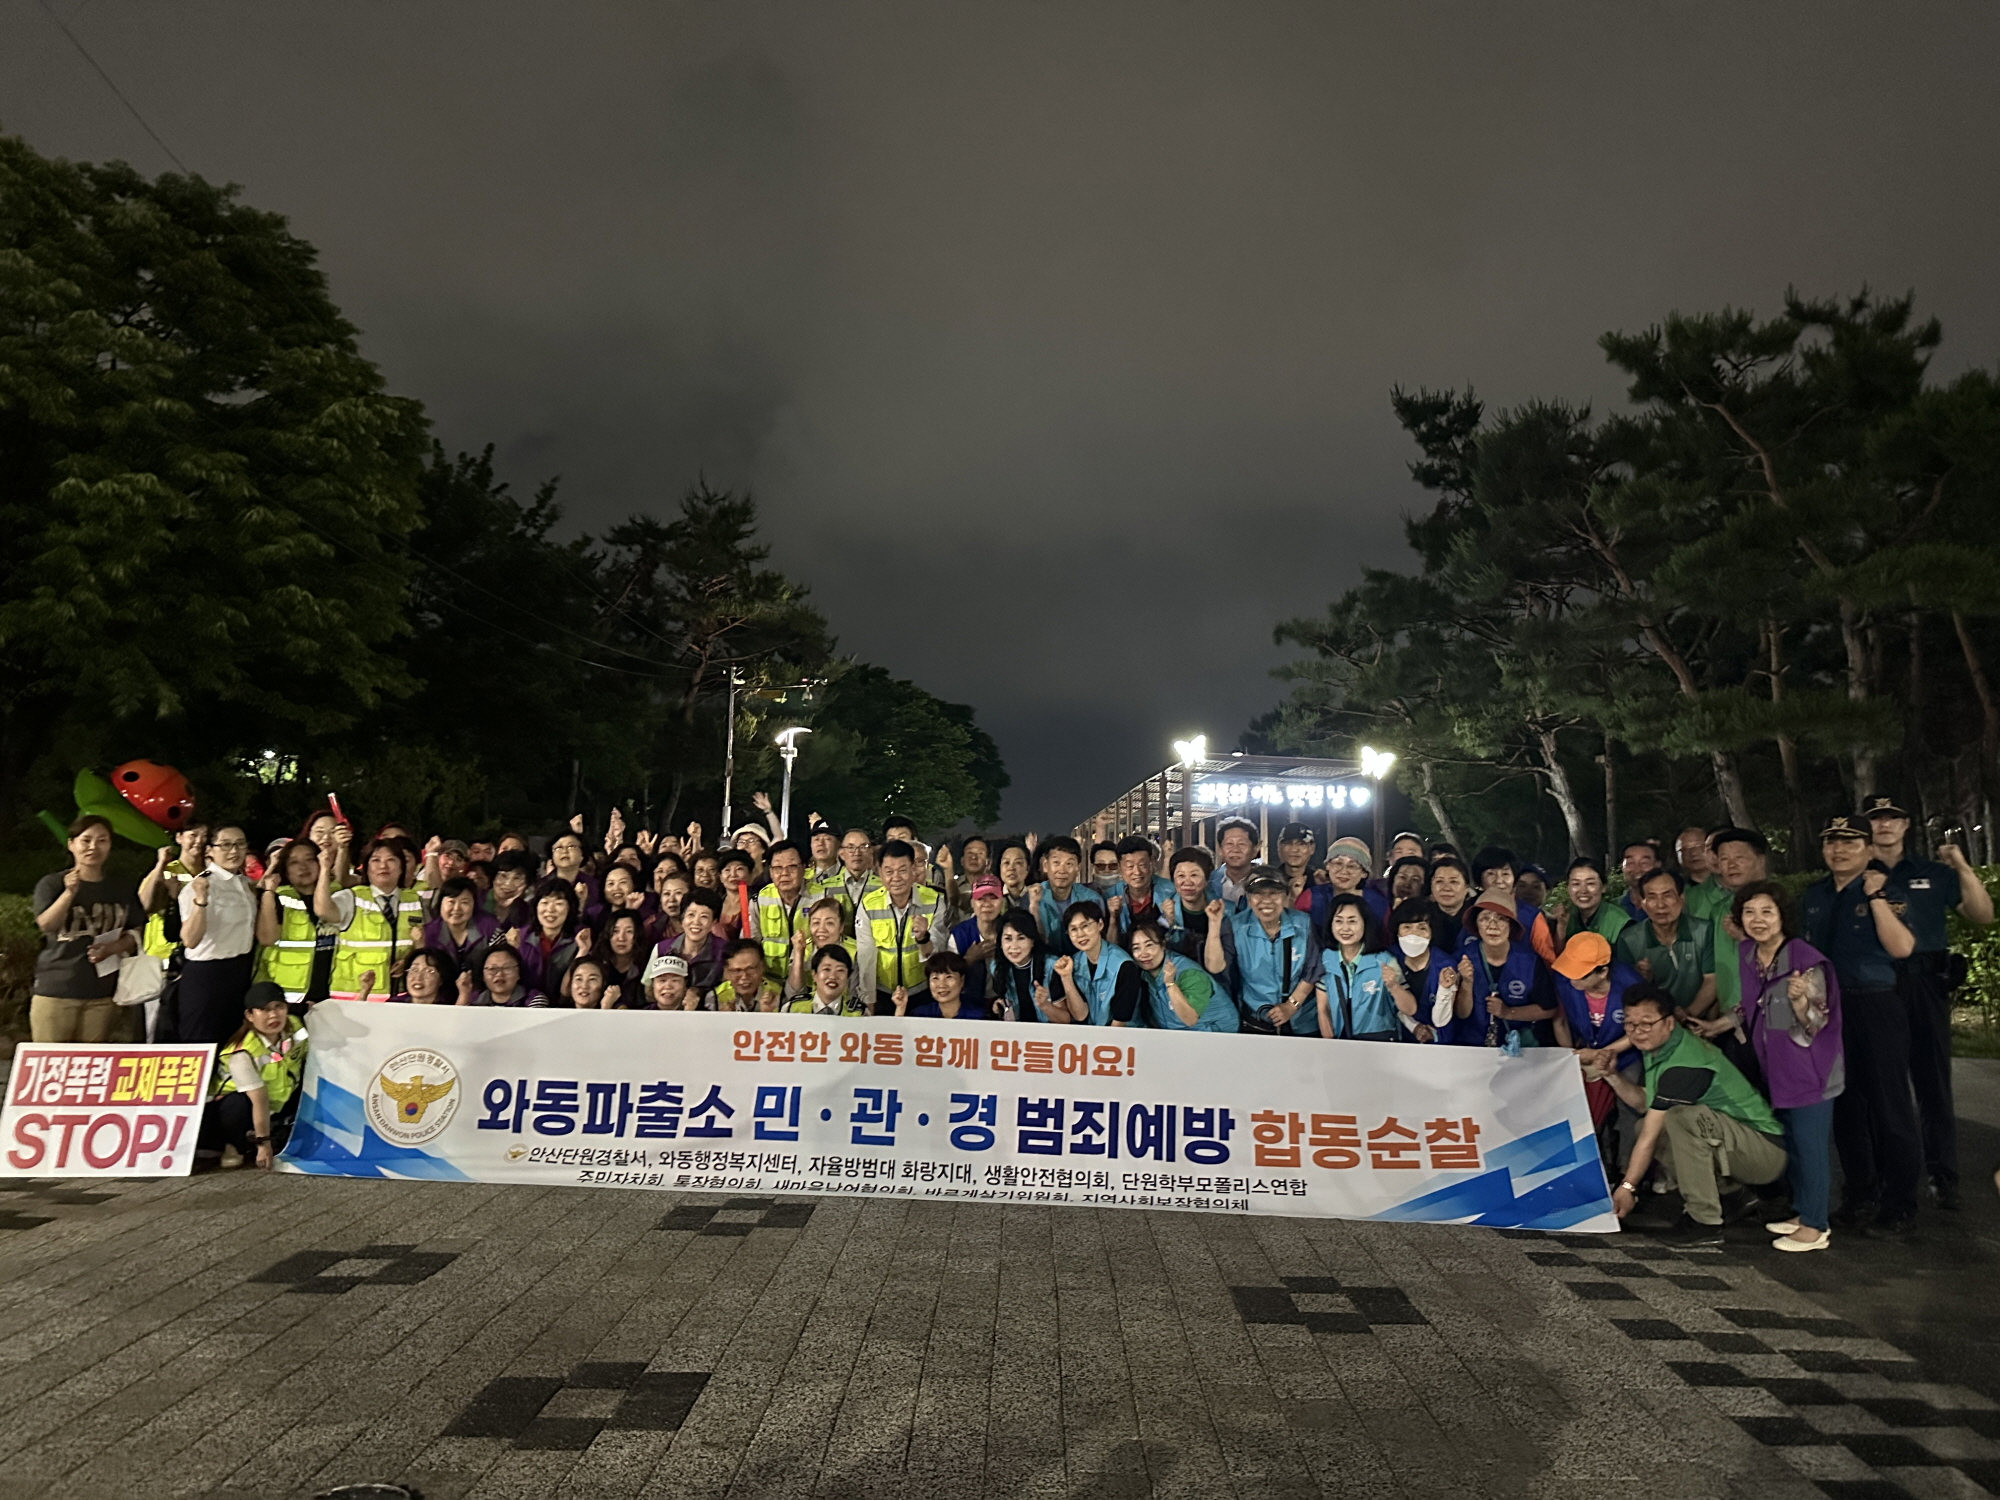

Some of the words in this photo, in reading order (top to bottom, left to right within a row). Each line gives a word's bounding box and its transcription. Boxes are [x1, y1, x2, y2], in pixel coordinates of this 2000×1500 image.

[653, 958, 685, 969] SPORT
[389, 1053, 450, 1075] 안산단원경찰서
[733, 1030, 831, 1063] 안전한
[838, 1032, 904, 1066] 와동
[914, 1034, 979, 1070] 함께
[990, 1039, 1136, 1077] 만들어요!
[18, 1056, 114, 1103] 가정폭력
[110, 1056, 203, 1103] 교제폭력
[371, 1093, 381, 1120] ANSAN
[379, 1118, 410, 1140] DANWON
[411, 1125, 436, 1140] POLICE
[435, 1098, 456, 1127] STATION
[477, 1078, 735, 1138] 와동파출소
[1017, 1096, 1236, 1166] 범죄예방
[1250, 1109, 1481, 1170] 합동순찰
[7, 1113, 189, 1170] STOP!
[527, 1147, 652, 1170] 안산단원경찰서,
[658, 1150, 802, 1176] 와동행정복지센터,
[808, 1156, 896, 1180] 자율방범대
[902, 1160, 977, 1186] 화랑지대,
[983, 1164, 1115, 1191] 생활안전협의회,
[1121, 1172, 1308, 1197] 단원학부모폴리스연합
